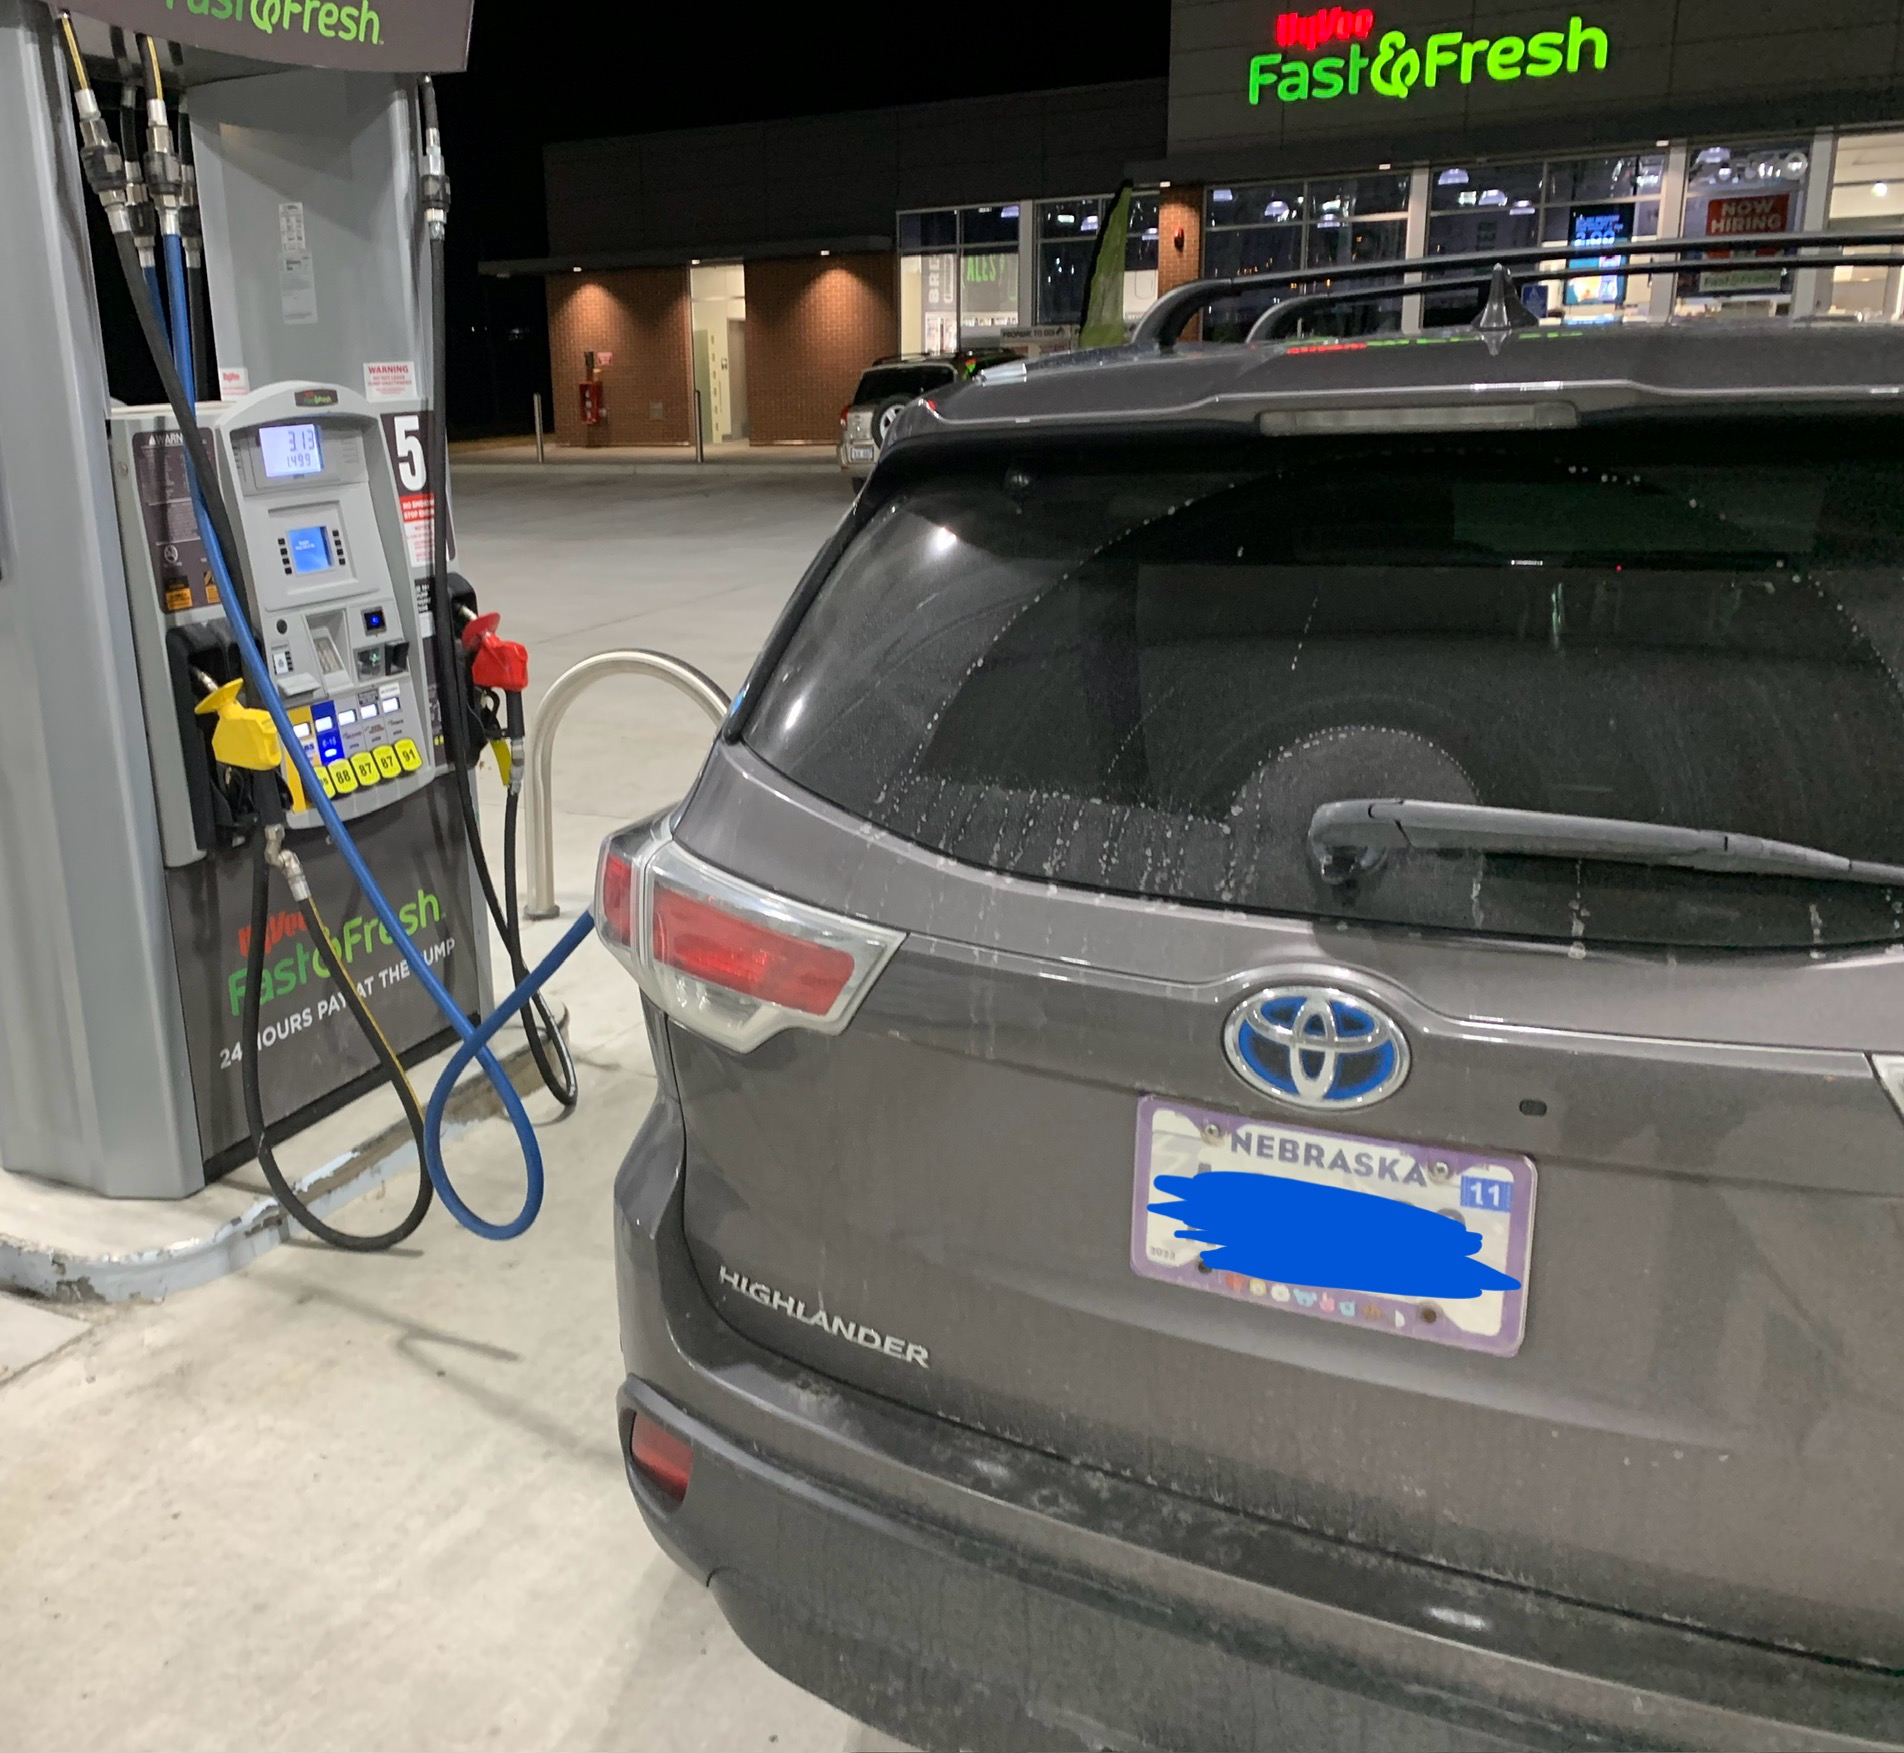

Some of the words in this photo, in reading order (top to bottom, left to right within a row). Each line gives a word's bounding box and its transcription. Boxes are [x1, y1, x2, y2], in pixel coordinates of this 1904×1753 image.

[1721, 199, 1774, 216] NOW
[1711, 213, 1781, 233] HIRING
[367, 364, 409, 374] WARNING
[394, 414, 427, 491] 5
[380, 755, 394, 769] 87
[402, 748, 417, 762] 91
[358, 762, 373, 777] 87
[219, 1041, 243, 1070] 24
[355, 976, 375, 1000] AT
[378, 959, 410, 989] THE
[421, 938, 456, 966] UMP
[1230, 1131, 1428, 1188] NEBRASKA
[1471, 1181, 1501, 1208] 11
[719, 1265, 930, 1369] HIGHLANDER
